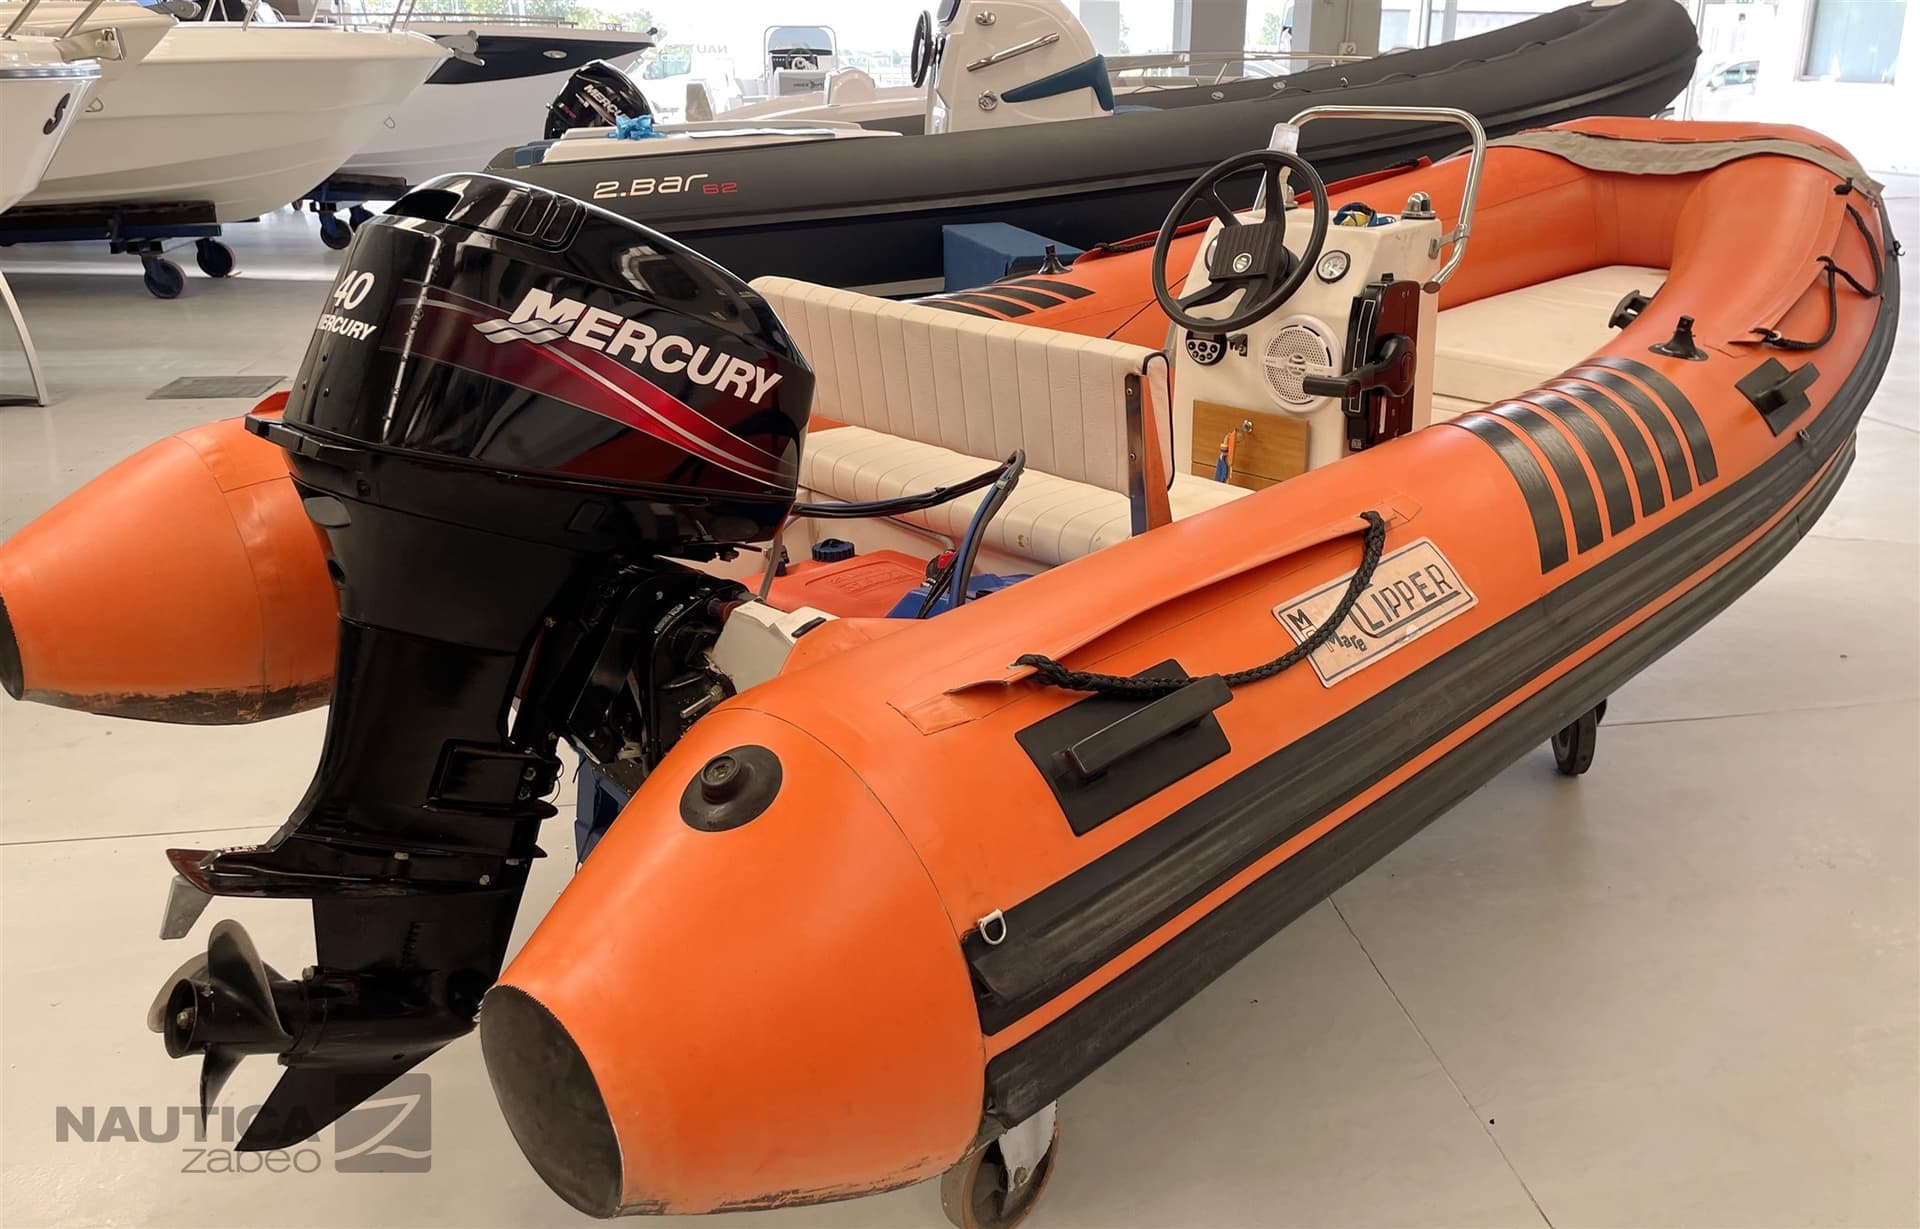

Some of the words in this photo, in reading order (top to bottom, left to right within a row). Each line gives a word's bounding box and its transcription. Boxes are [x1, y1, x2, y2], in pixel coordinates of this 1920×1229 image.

[583, 84, 630, 119] MERCU
[333, 270, 375, 310] 40
[507, 287, 784, 405] MERCURY
